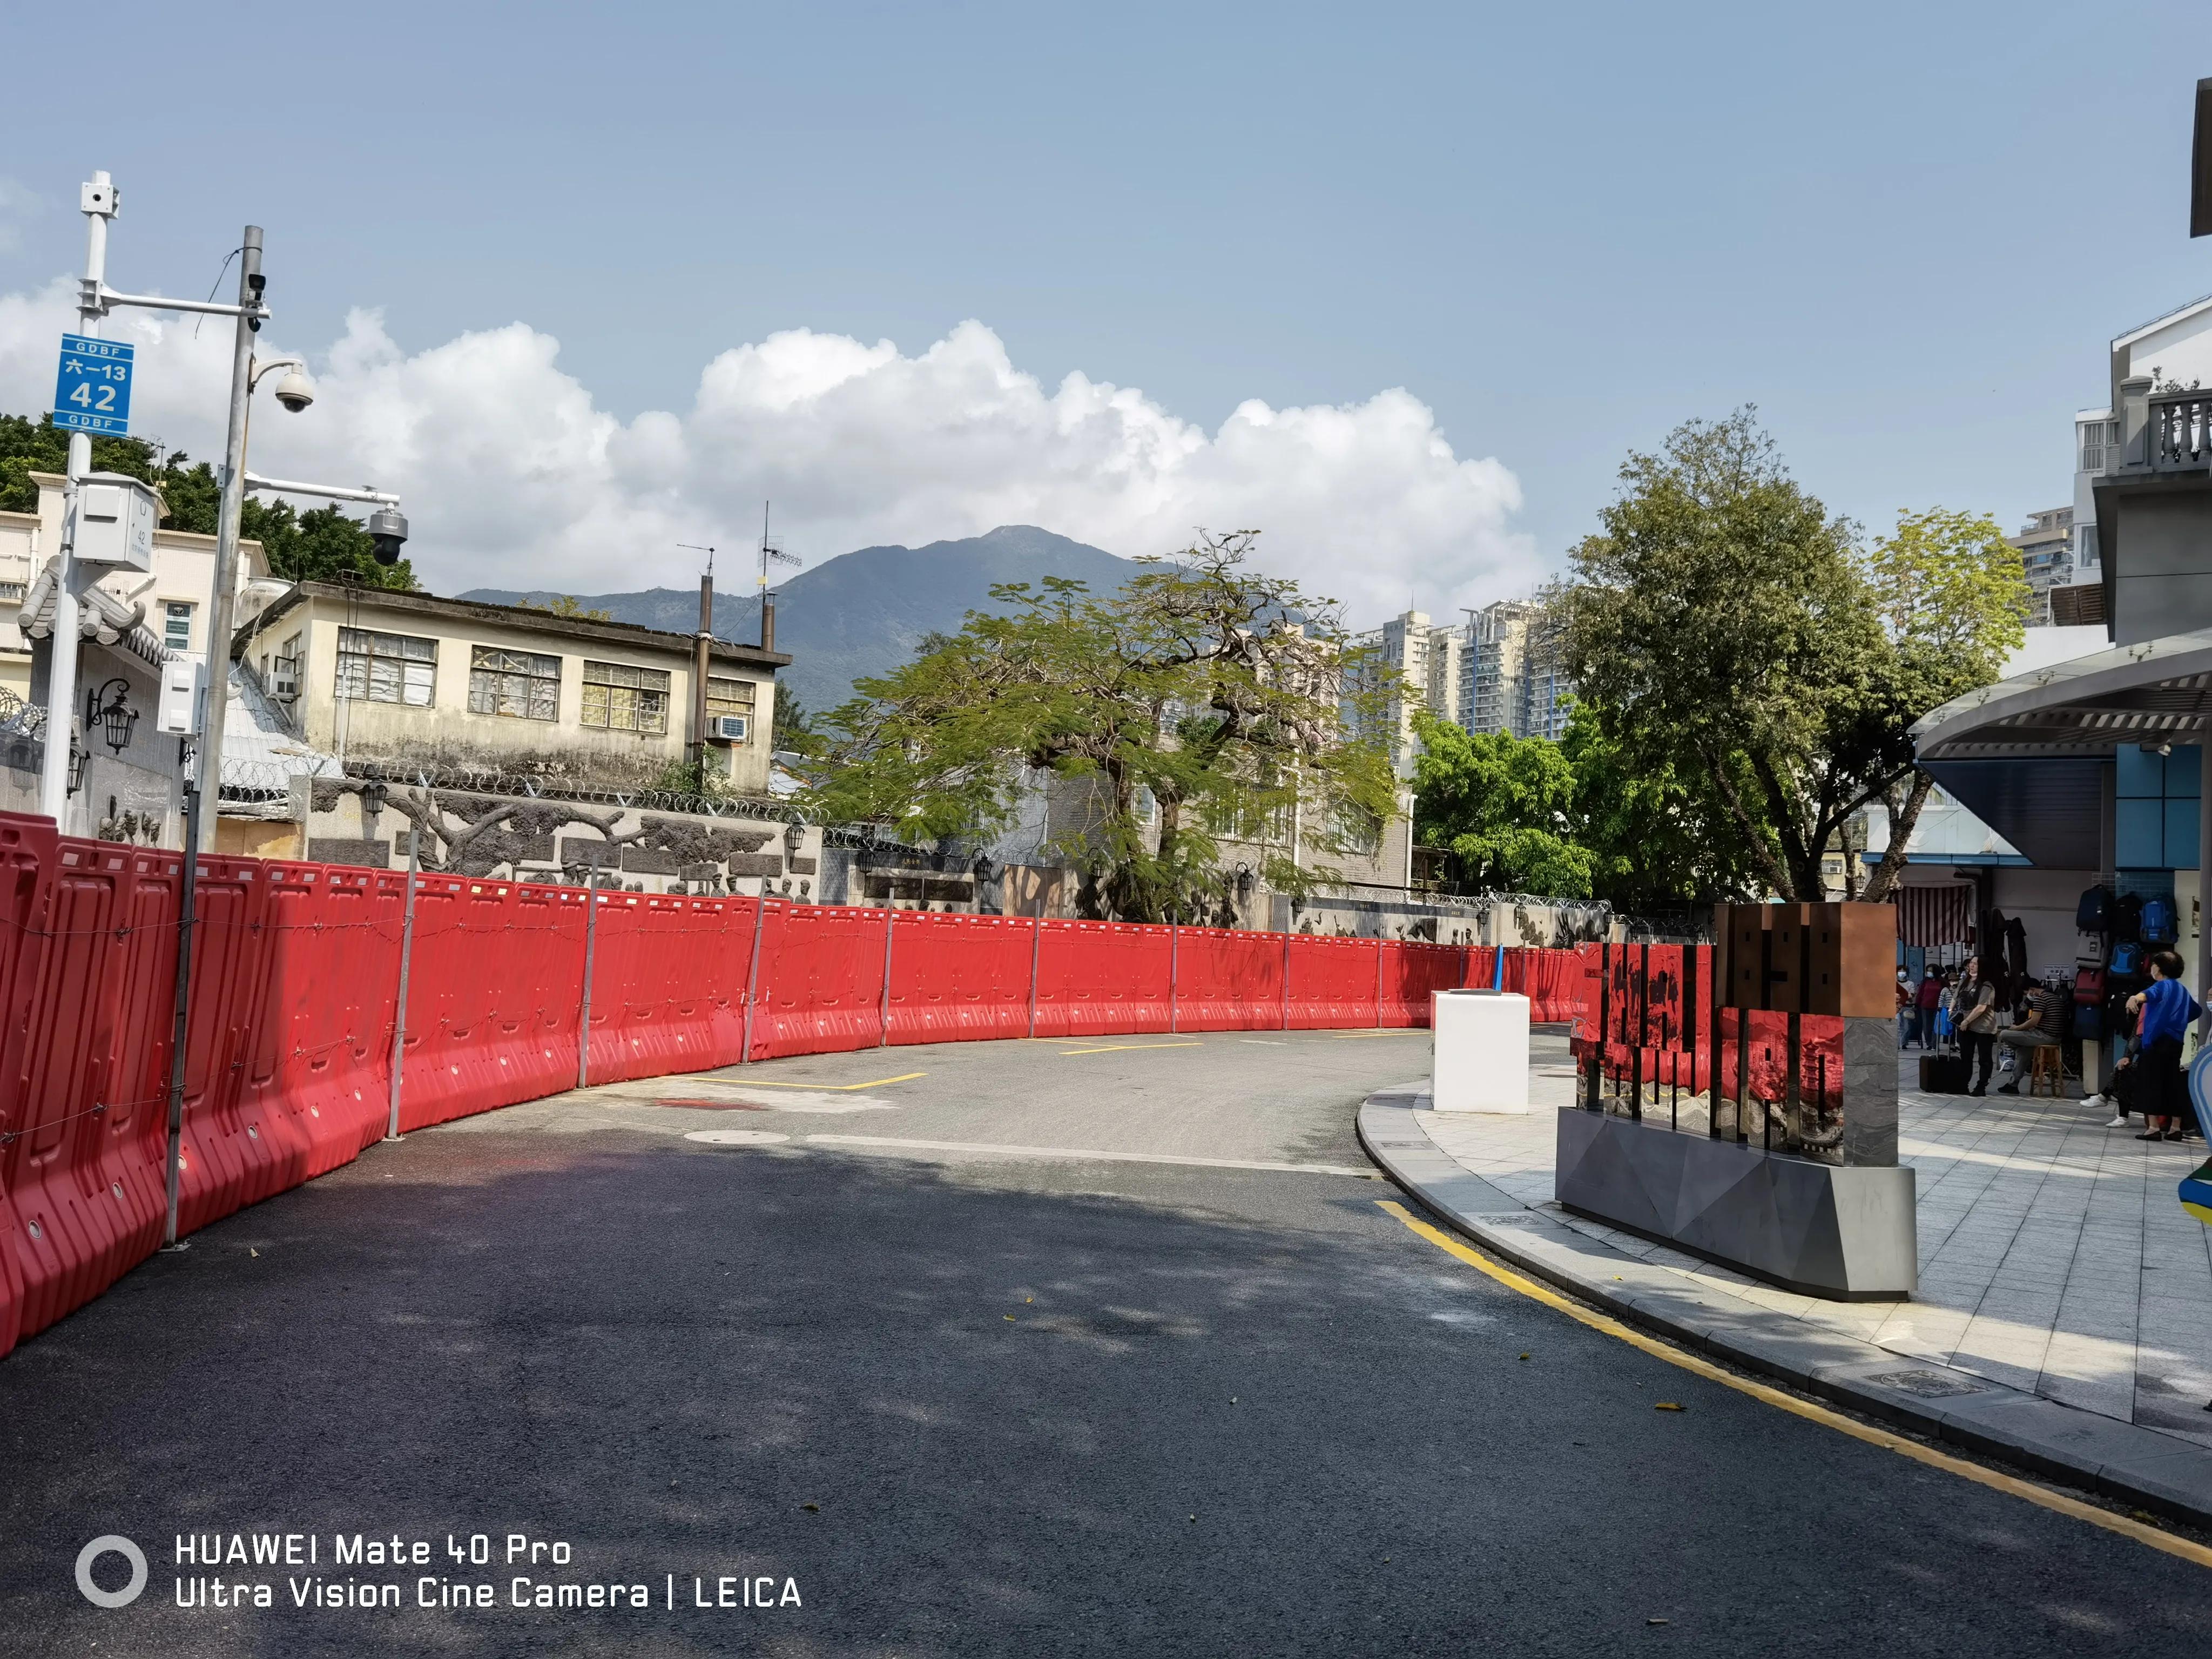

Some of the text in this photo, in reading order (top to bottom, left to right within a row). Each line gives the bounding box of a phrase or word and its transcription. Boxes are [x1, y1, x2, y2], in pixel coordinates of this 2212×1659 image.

[76, 342, 119, 356] GDBF
[70, 382, 116, 412] 42
[69, 415, 112, 428] GDBF
[138, 530, 145, 545] 42
